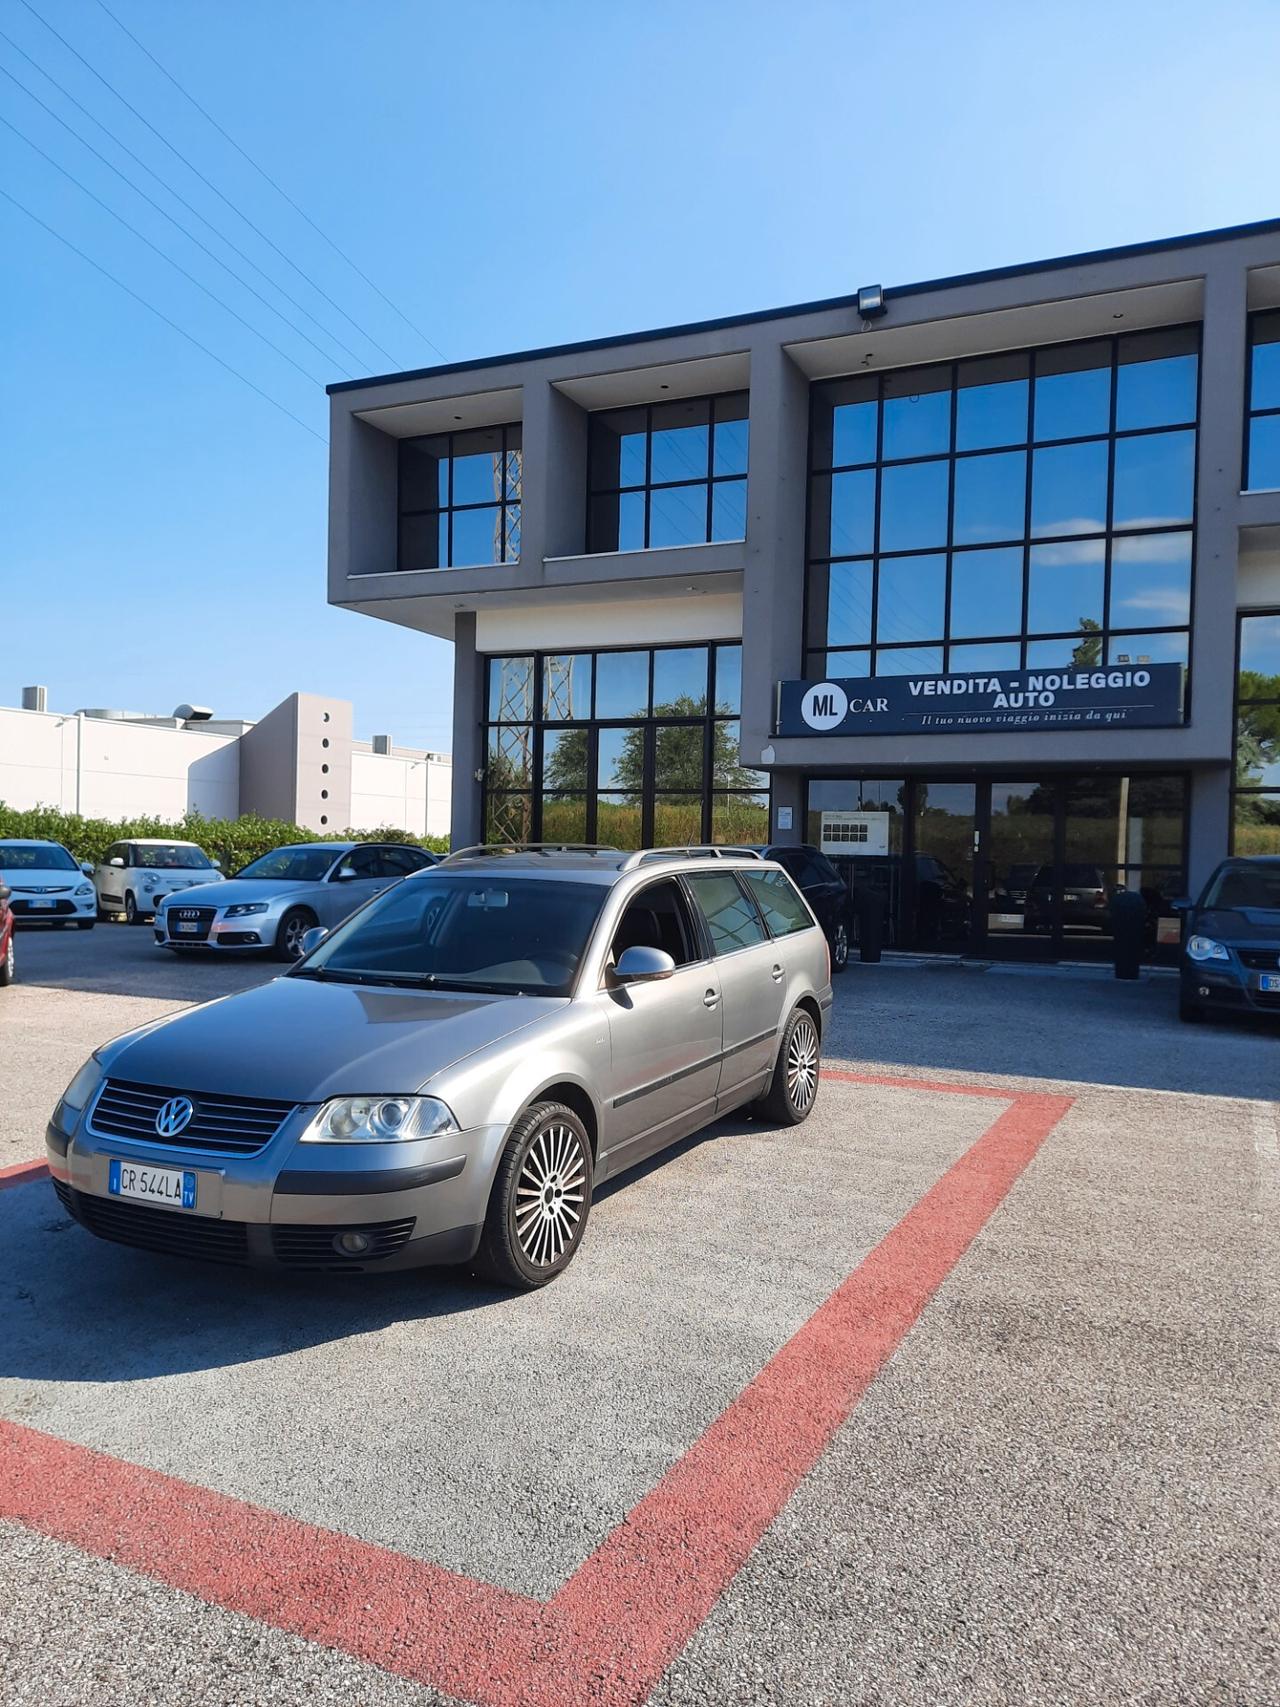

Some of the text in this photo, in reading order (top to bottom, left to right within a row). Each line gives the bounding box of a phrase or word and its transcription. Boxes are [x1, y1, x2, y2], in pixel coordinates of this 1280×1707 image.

[908, 678, 1002, 696] VENDITA
[1028, 671, 1151, 691] NOLEGGIO
[813, 695, 889, 717] ML CAR
[993, 691, 1055, 708] AUTO
[935, 716, 953, 724] tuo
[957, 715, 992, 724] nuovo
[996, 713, 1040, 725] viaggio
[1044, 711, 1081, 721] inizia
[1086, 710, 1101, 720] da
[1105, 709, 1127, 722] qui
[121, 1168, 137, 1191] CR
[140, 1172, 182, 1200] 544LA
